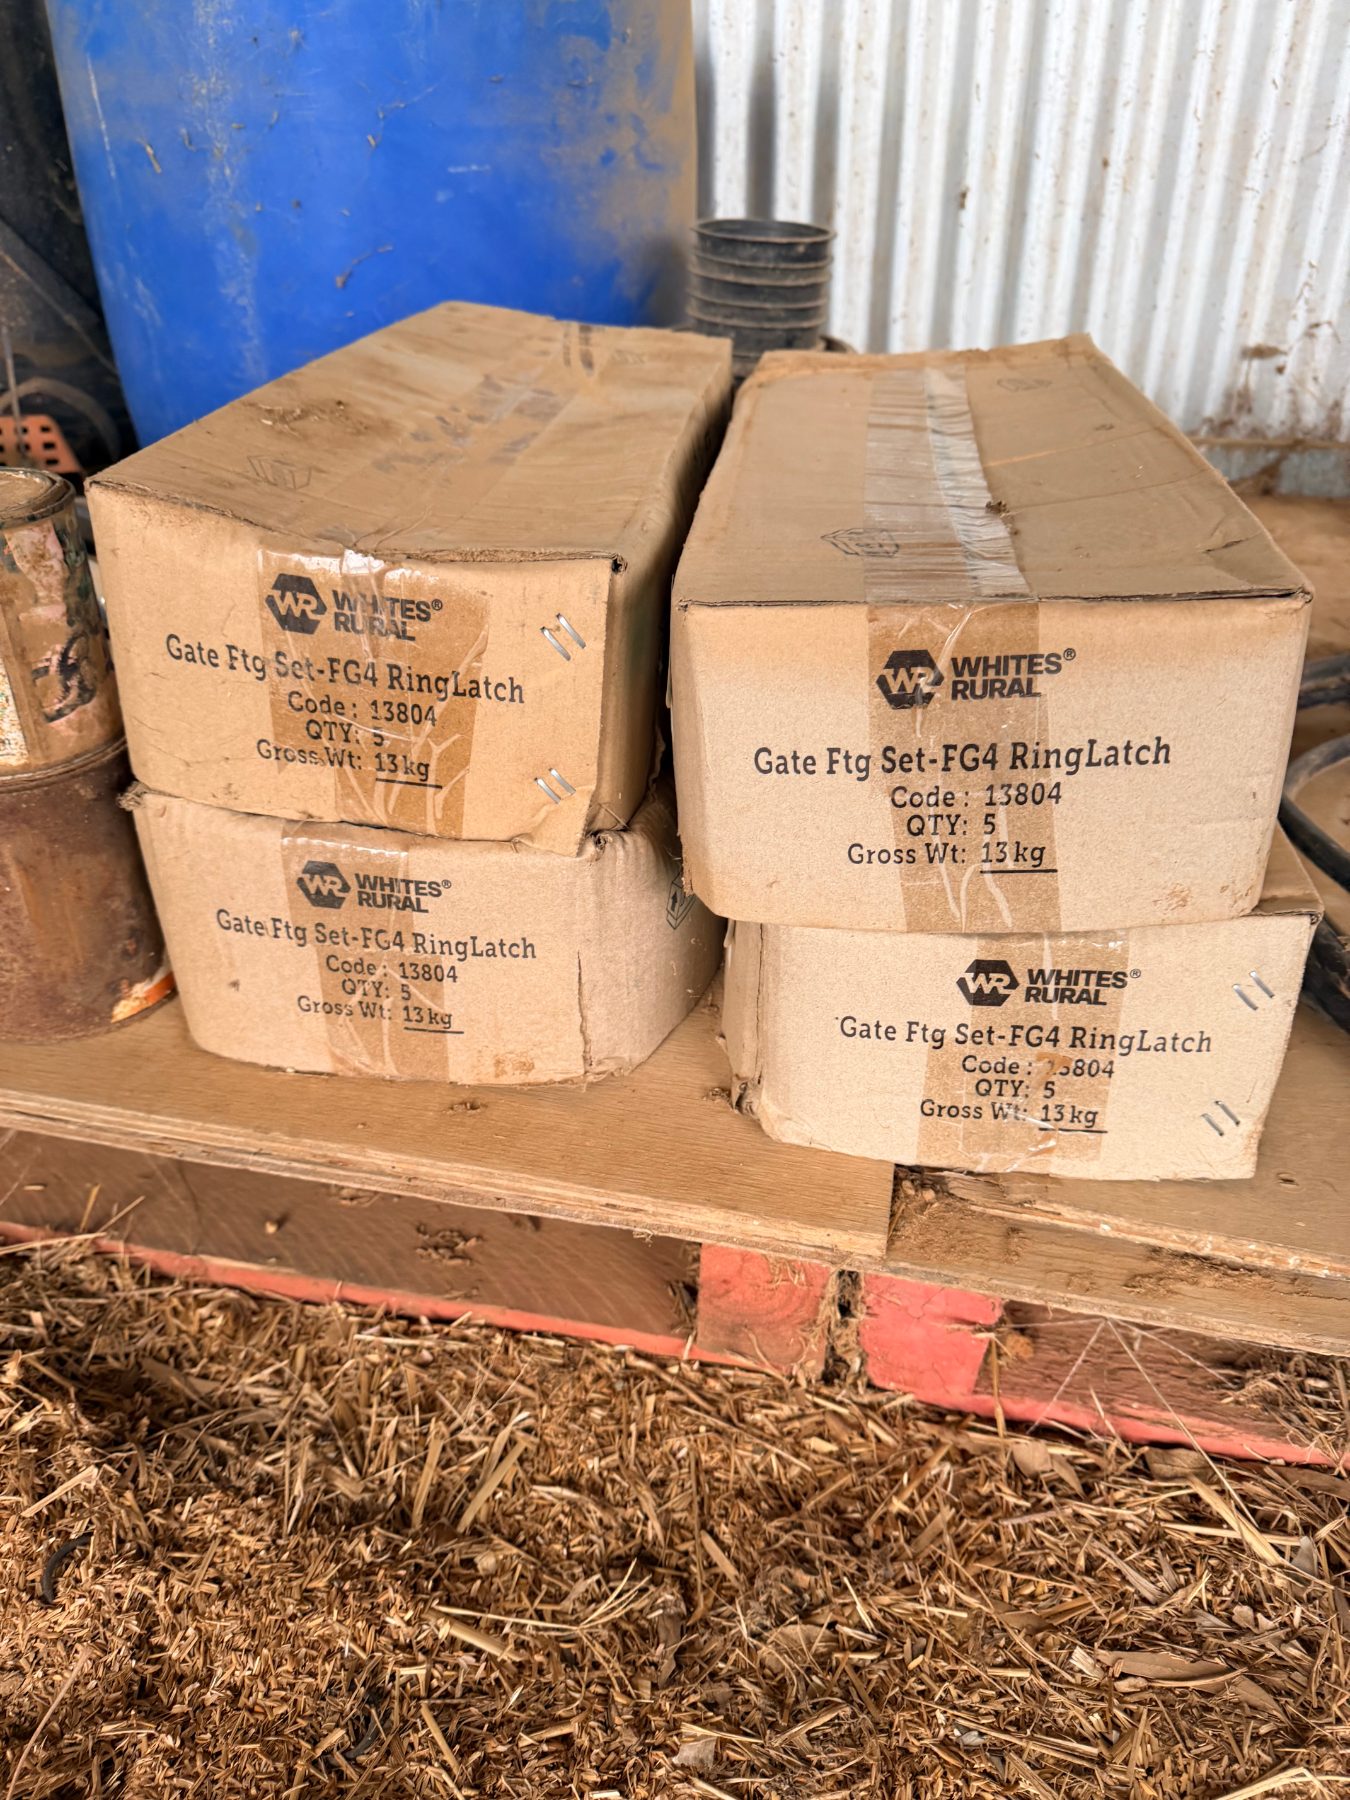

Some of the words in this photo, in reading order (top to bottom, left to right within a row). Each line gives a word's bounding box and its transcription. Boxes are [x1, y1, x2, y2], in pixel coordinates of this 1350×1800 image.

[333, 611, 416, 642] RURAL
[165, 633, 220, 669] Gate
[226, 644, 266, 681] Ftg
[275, 650, 379, 687] Set-FG4
[386, 663, 525, 704] RingLatch
[950, 677, 1042, 701] RURAL
[370, 699, 437, 727] 13804
[305, 720, 360, 746] QTY:
[373, 727, 385, 747] 5
[256, 738, 318, 765] Gross
[324, 746, 362, 771] Wt:
[753, 746, 817, 776] Gate
[825, 746, 872, 782] Ftg
[881, 743, 999, 774] Set-FG4
[1008, 735, 1171, 776] RingLatch
[984, 781, 1063, 807] 13804
[906, 814, 968, 838] QTY:
[983, 813, 996, 835] 5
[847, 842, 917, 866] Gross
[924, 842, 966, 865] Wt:
[357, 890, 429, 914] RURAL
[216, 908, 265, 937] Gate
[271, 917, 307, 948] Ftg
[315, 922, 405, 951] Set-FG4
[411, 931, 537, 962] RingLatch
[398, 961, 458, 984] 13804
[341, 978, 390, 999] QTY:
[400, 983, 412, 1001] 5
[1023, 986, 1107, 1006] RURAL
[297, 995, 353, 1017] Gross
[359, 1001, 392, 1021] Wt:
[839, 1015, 897, 1042] Gate
[905, 1020, 946, 1049] Ftg
[954, 1022, 1060, 1049] Set-FG4
[1068, 1026, 1213, 1057] RingLatch
[975, 1079, 1031, 1100] QTY:
[1043, 1080, 1056, 1100] 5
[920, 1098, 983, 1120] Gross
